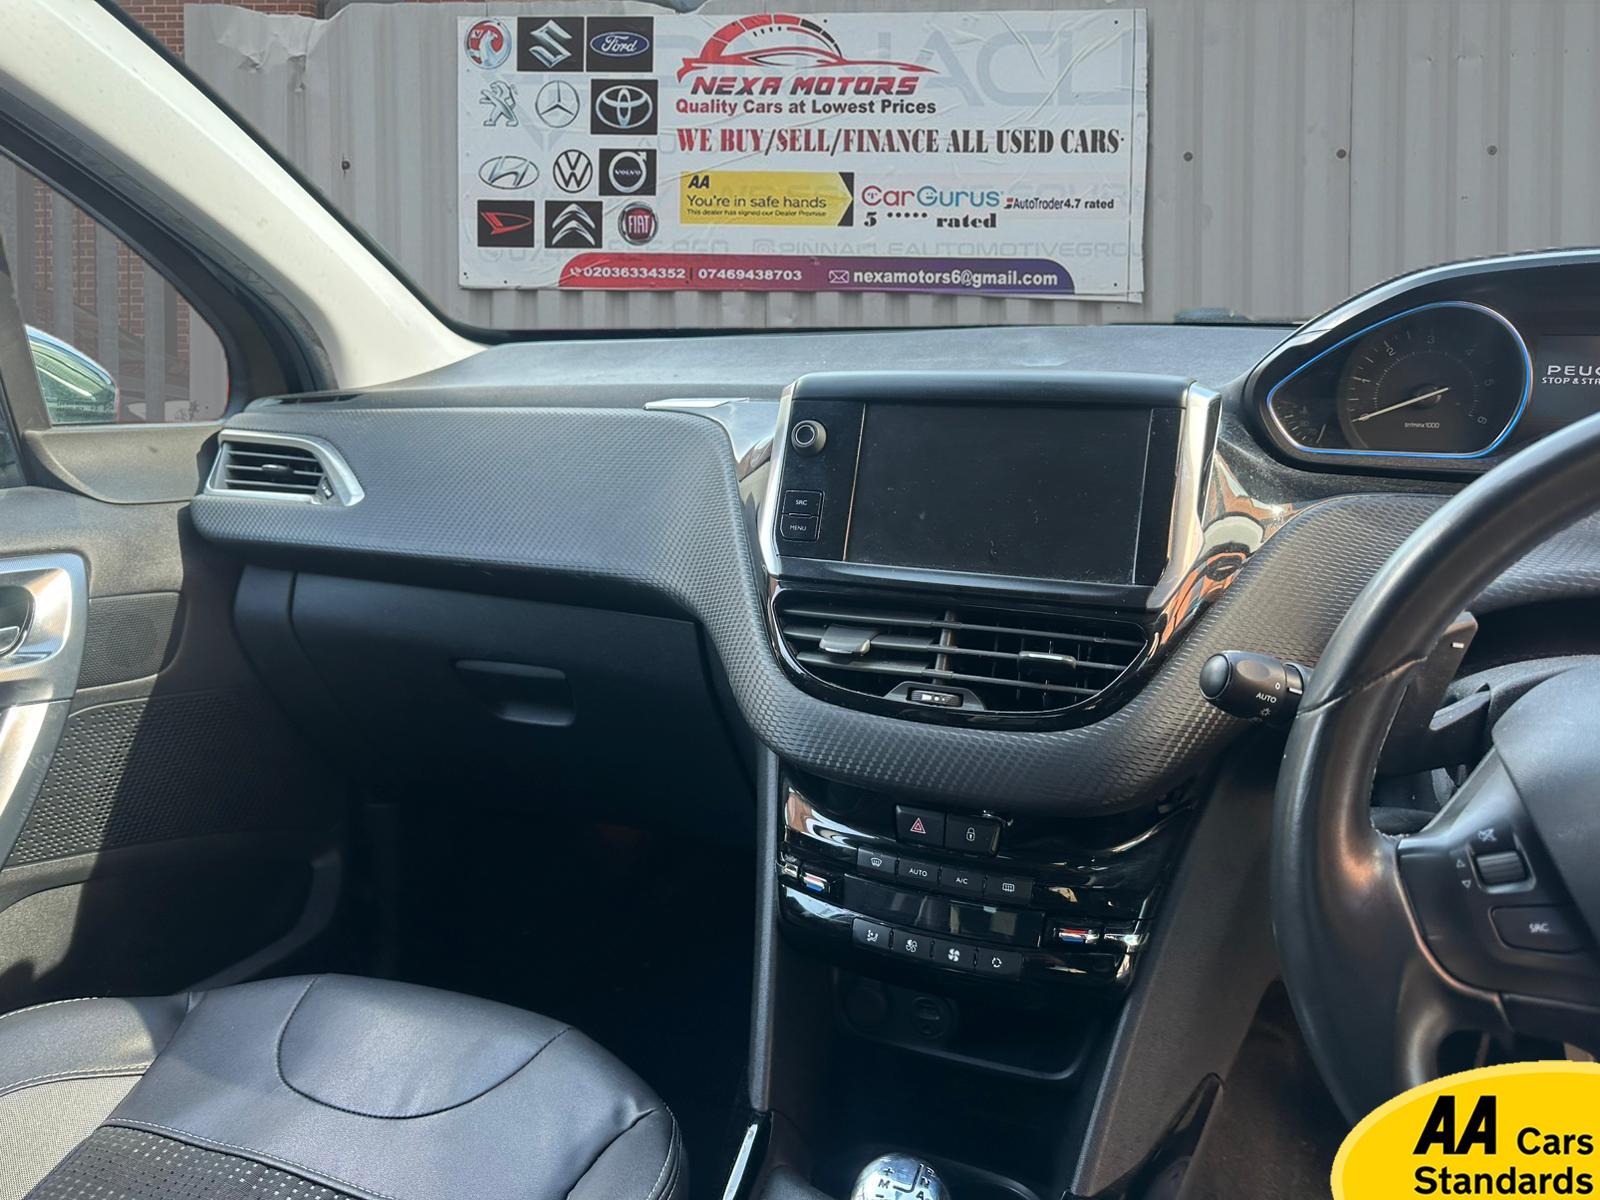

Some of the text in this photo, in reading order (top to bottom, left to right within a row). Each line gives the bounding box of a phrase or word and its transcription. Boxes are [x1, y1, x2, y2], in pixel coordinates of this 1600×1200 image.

[601, 35, 637, 52] Ford
[691, 77, 919, 95] NEXA MOTORS
[676, 99, 936, 116] Quality Cars at Lowest Prices
[677, 128, 712, 152] WE
[720, 128, 939, 156] BUY/SELL/FINANCE
[946, 129, 989, 153] ALL
[996, 129, 1054, 153] USED
[688, 175, 710, 189] AA
[687, 194, 827, 208] You're in safe hands
[862, 185, 1001, 207] CarGurus
[1084, 198, 1114, 209] rated
[628, 215, 649, 234] FIAT
[864, 211, 996, 228] 5 rated
[584, 267, 802, 281] 02036334352 07469438703
[853, 269, 1058, 286] nexamotors6@gmail.com
[789, 524, 807, 532] MENU
[1256, 692, 1277, 704] AUTO
[908, 868, 928, 877] AUTO
[955, 877, 969, 885] A/C
[1529, 922, 1549, 933] SRC
